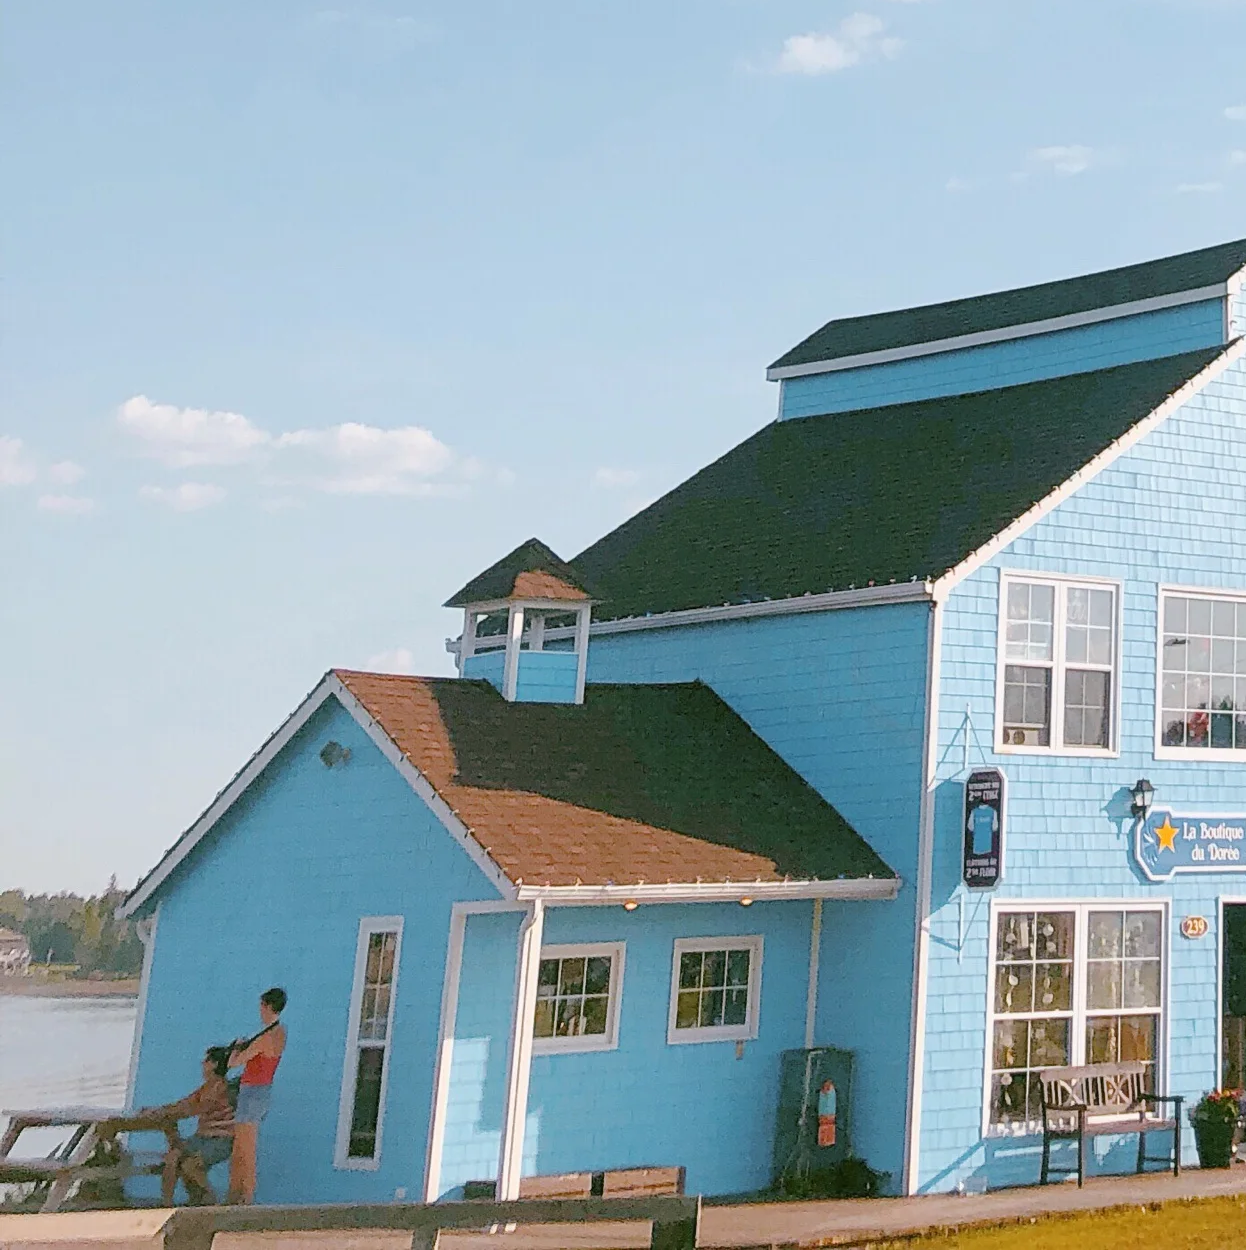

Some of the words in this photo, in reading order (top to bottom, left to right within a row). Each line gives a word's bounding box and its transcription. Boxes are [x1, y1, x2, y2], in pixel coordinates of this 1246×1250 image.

[1183, 822, 1196, 841] La
[1200, 822, 1244, 842] Boutique
[1192, 843, 1204, 860] du
[1208, 843, 1239, 860] Dorée
[1187, 919, 1205, 934] 239
